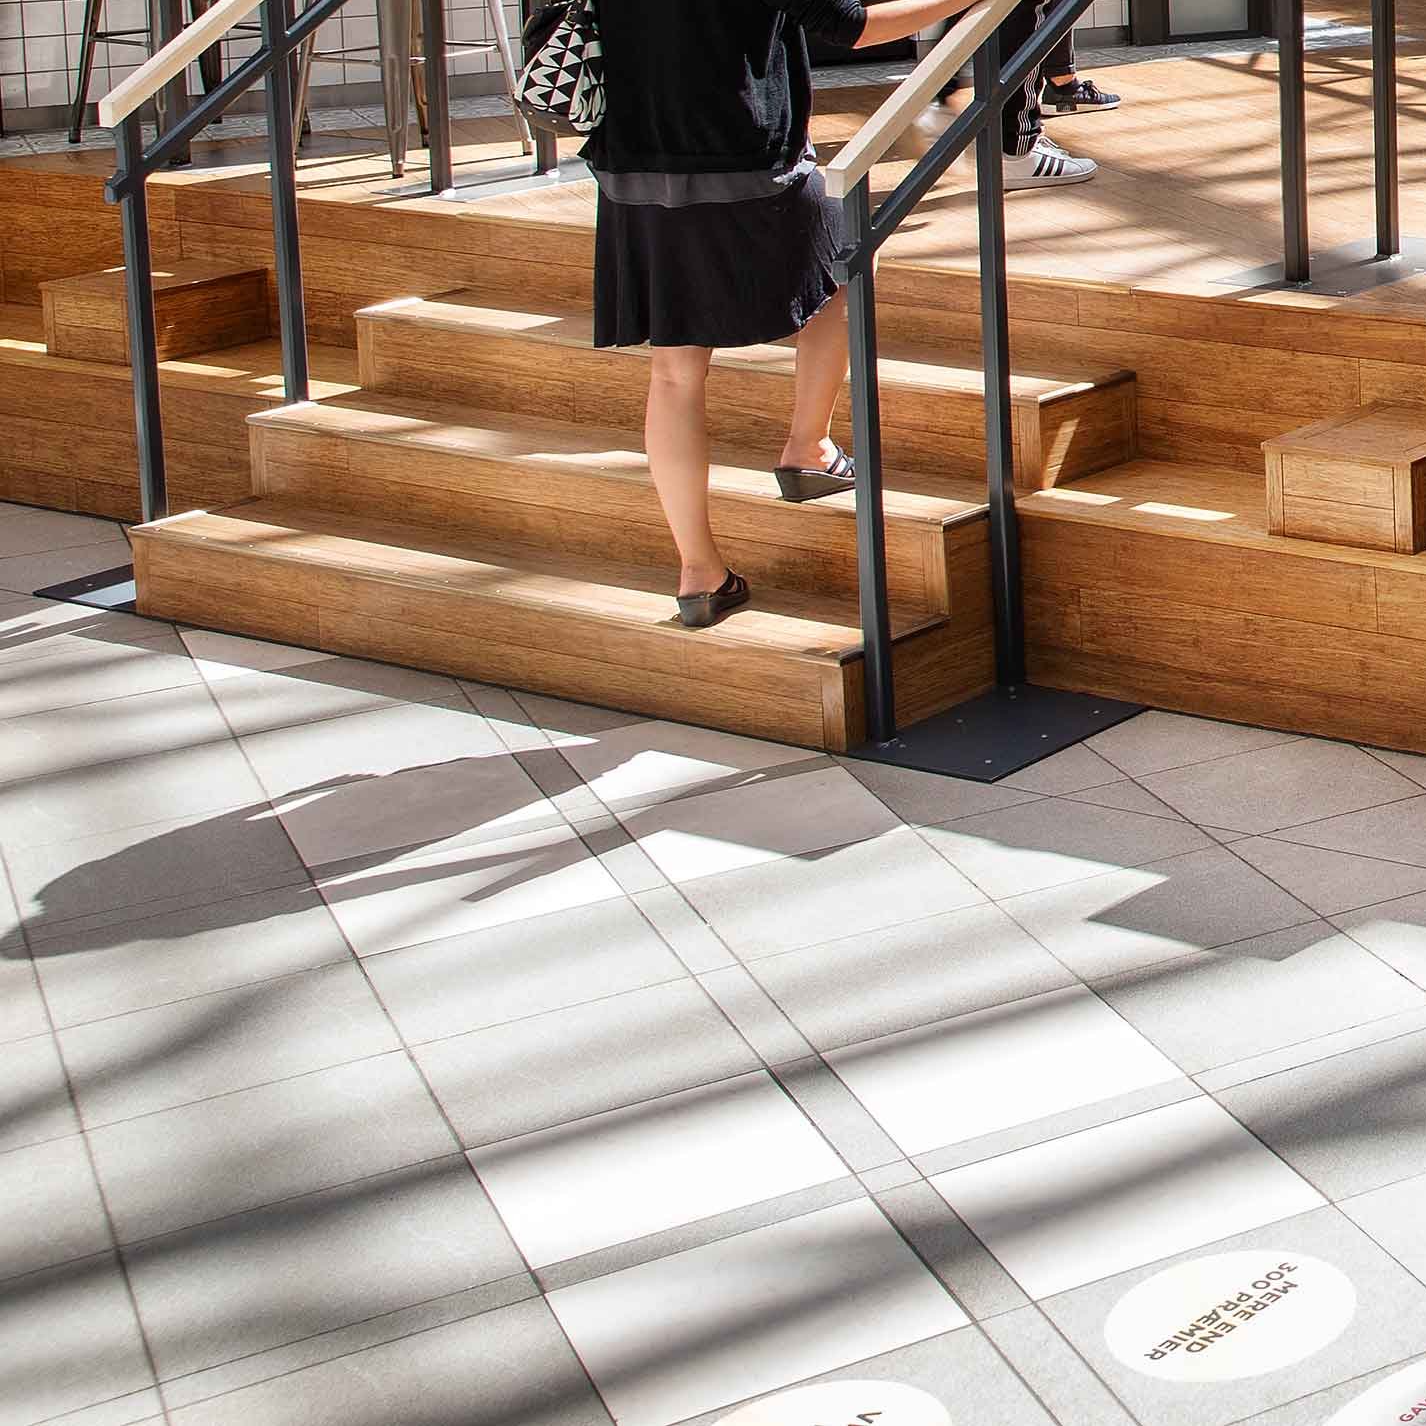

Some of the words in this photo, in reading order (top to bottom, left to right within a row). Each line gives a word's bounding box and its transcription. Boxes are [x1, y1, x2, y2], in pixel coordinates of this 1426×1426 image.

[1233, 1281, 1298, 1321] MERE
[1144, 1291, 1253, 1360] PRÆMIER
[1186, 1322, 1237, 1353] END
